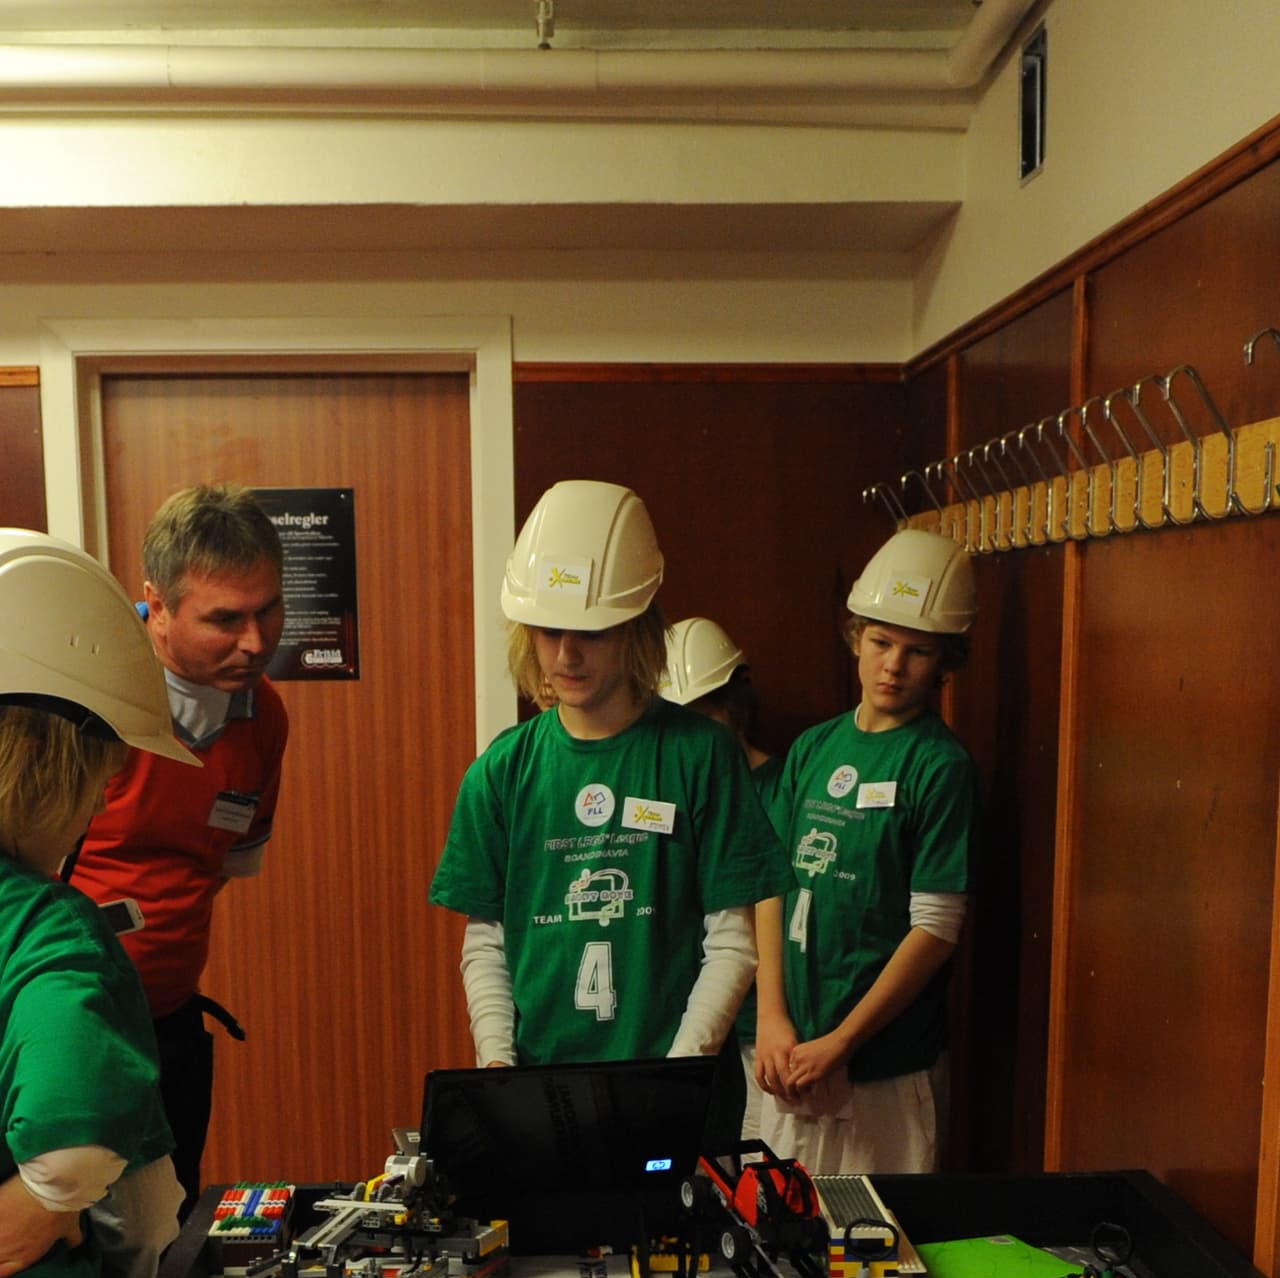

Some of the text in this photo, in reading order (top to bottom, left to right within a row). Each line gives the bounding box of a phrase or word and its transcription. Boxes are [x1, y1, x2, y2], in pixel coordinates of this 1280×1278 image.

[270, 512, 329, 529] selregler
[587, 807, 604, 816] FLL
[533, 914, 562, 924] TEAM
[788, 888, 813, 953] 4
[575, 941, 616, 1022] 4
